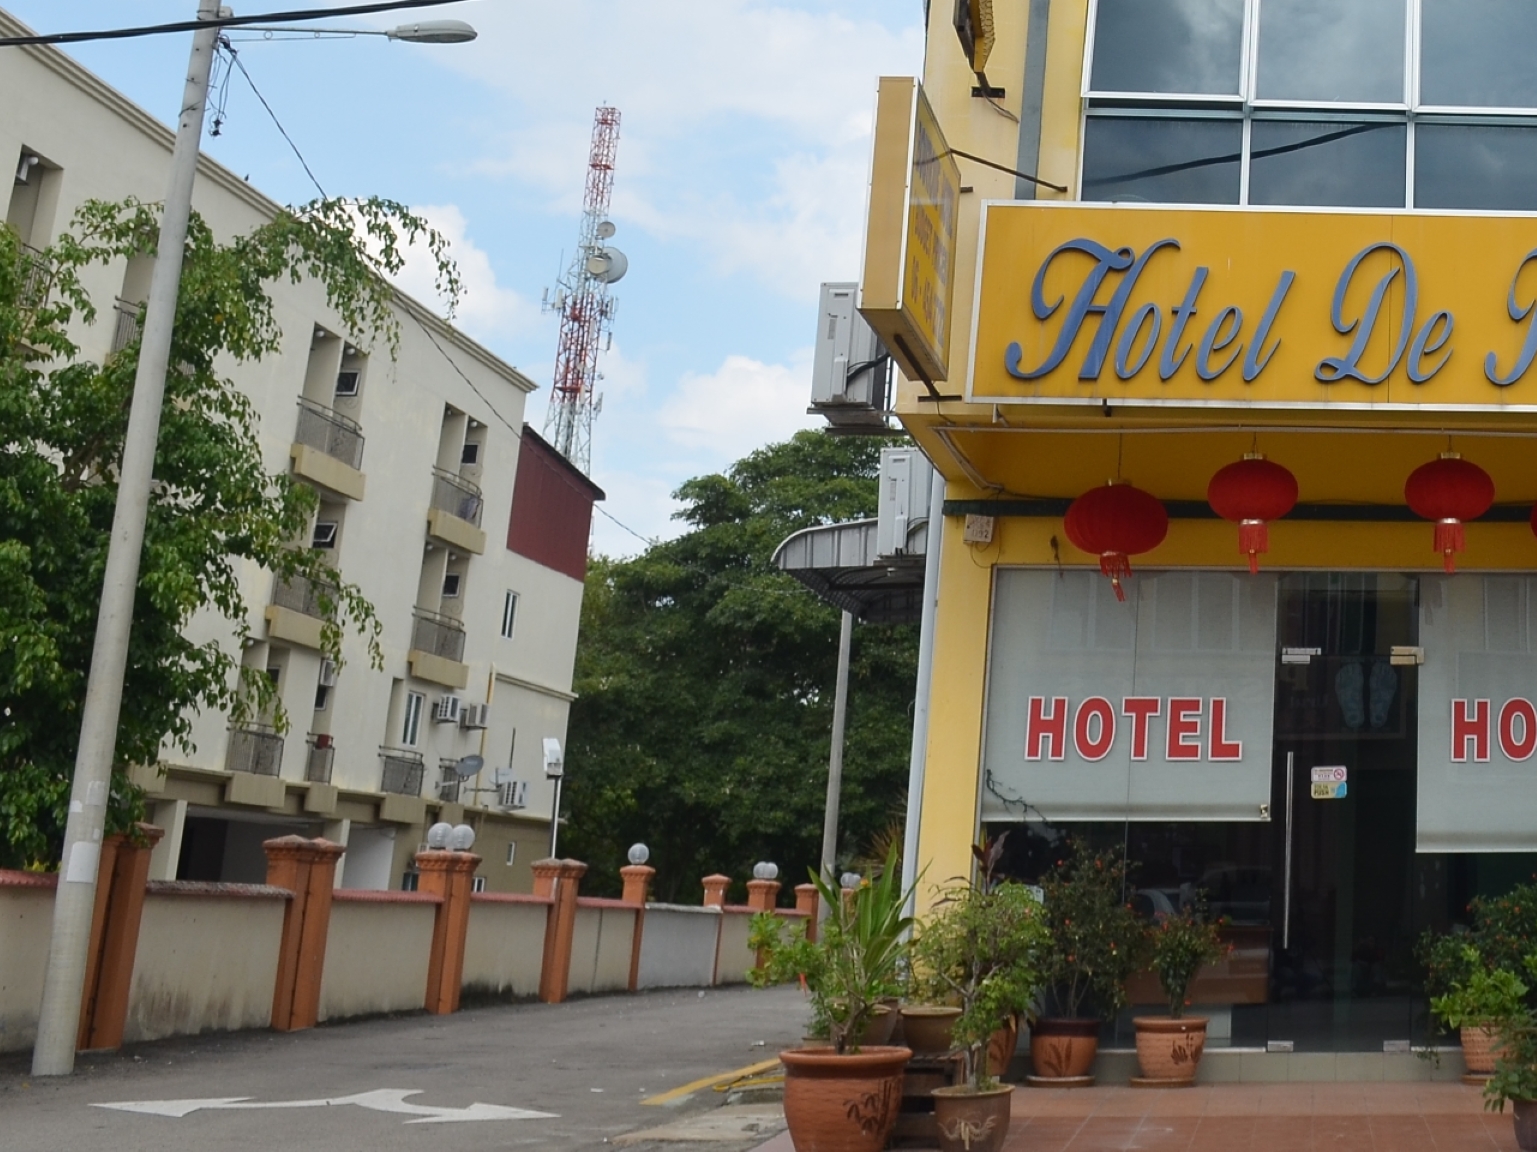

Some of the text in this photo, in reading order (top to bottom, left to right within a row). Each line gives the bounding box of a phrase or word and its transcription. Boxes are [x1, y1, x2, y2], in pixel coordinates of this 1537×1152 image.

[1003, 238, 1296, 382] Hotel
[1313, 241, 1454, 385] De
[1025, 696, 1242, 761] HOTEL
